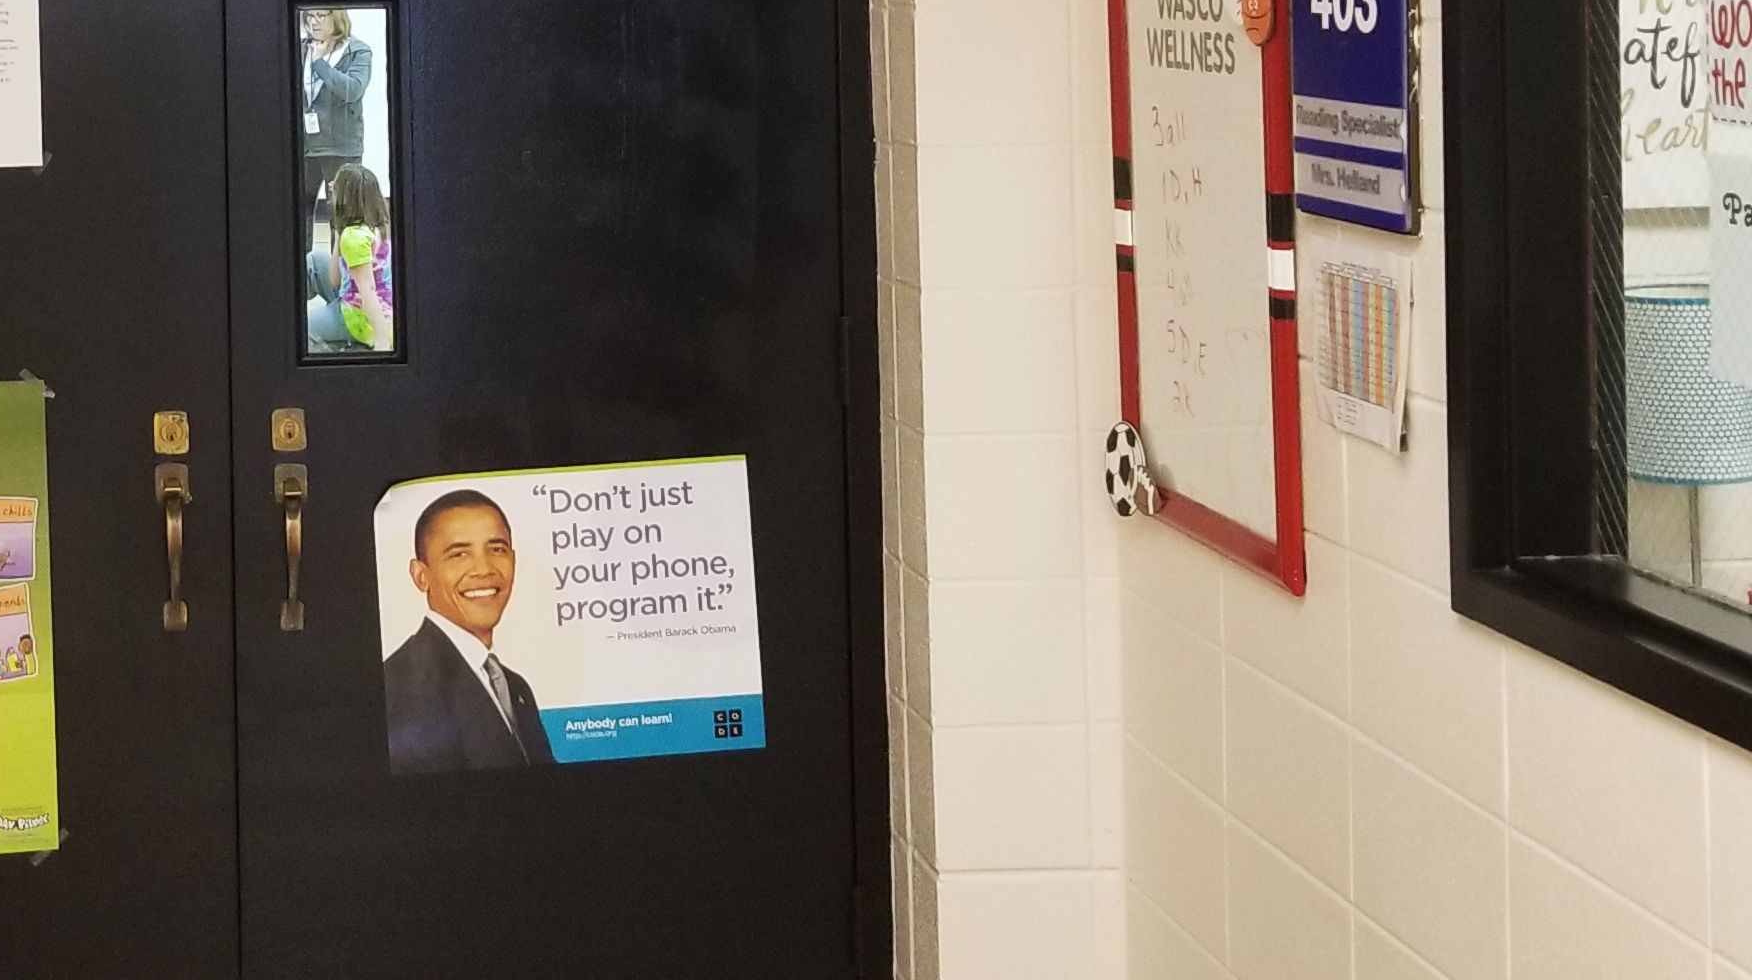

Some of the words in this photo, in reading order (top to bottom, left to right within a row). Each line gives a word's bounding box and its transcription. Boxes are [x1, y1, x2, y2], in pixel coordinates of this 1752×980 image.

[1146, 27, 1236, 75] WELLNESS
[1623, 17, 1700, 109] atef
[1712, 57, 1746, 110] the
[1722, 192, 1752, 228] Pa
[2, 504, 34, 517] chills
[639, 480, 694, 514] just
[551, 522, 615, 555] play
[623, 522, 663, 545] on
[552, 561, 622, 591] your
[630, 552, 735, 586] phone,
[555, 592, 688, 627] program
[616, 628, 663, 641] President
[664, 625, 699, 638] Barack
[700, 623, 737, 635] Obama
[565, 717, 617, 732] Anybody
[618, 716, 639, 727] can
